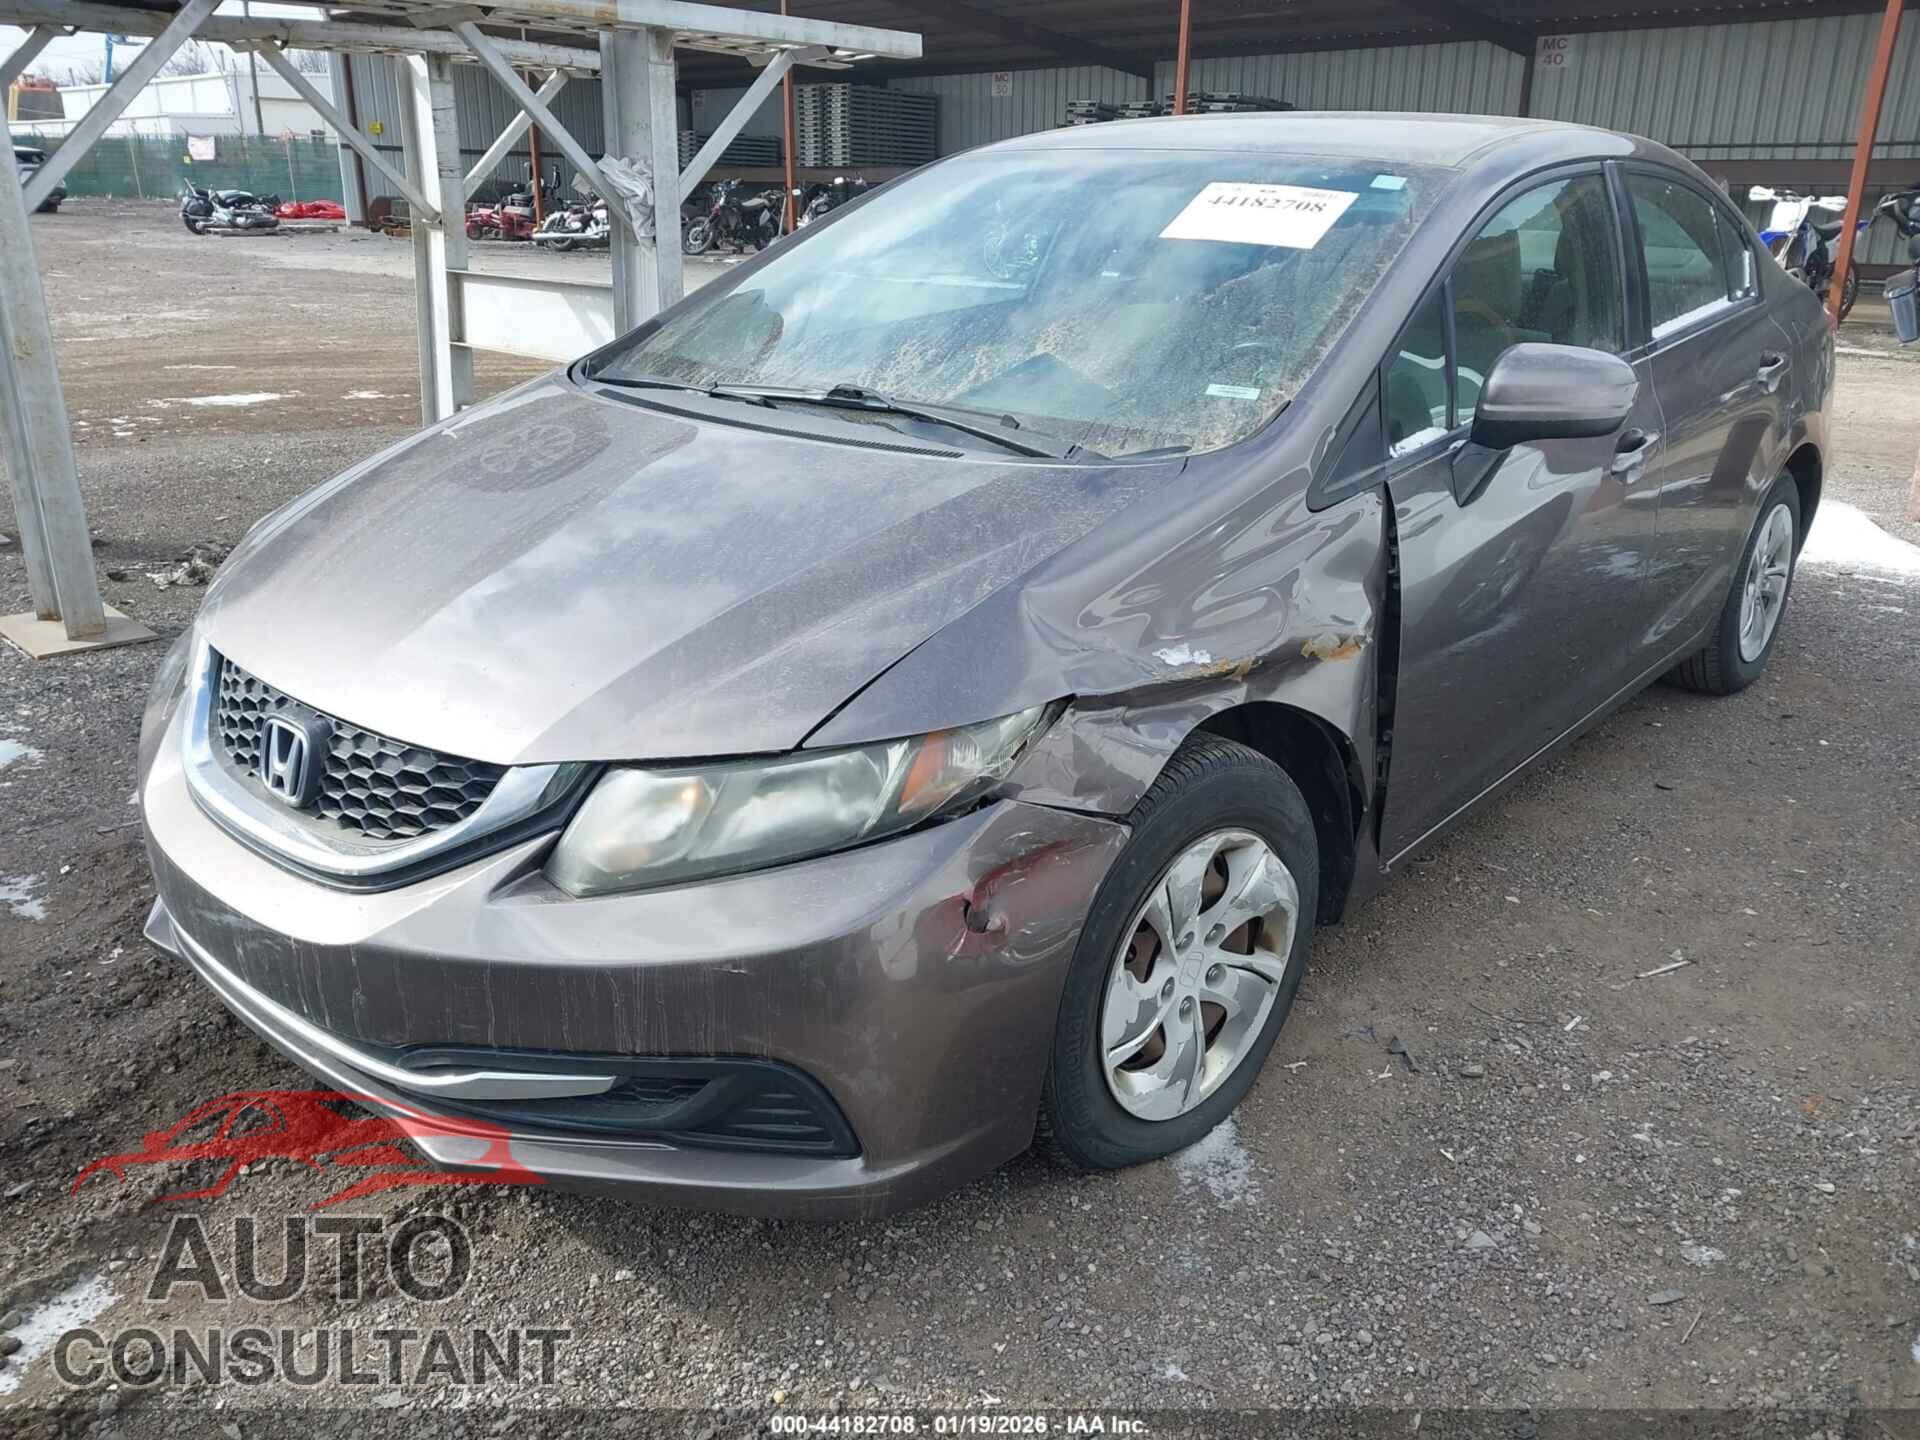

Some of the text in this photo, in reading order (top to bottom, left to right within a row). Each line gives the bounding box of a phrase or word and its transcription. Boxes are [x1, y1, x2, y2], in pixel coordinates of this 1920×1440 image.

[1543, 38, 1568, 50] MC
[1543, 53, 1565, 66] 40
[994, 73, 1009, 83] MC
[1208, 195, 1327, 213] 44182708
